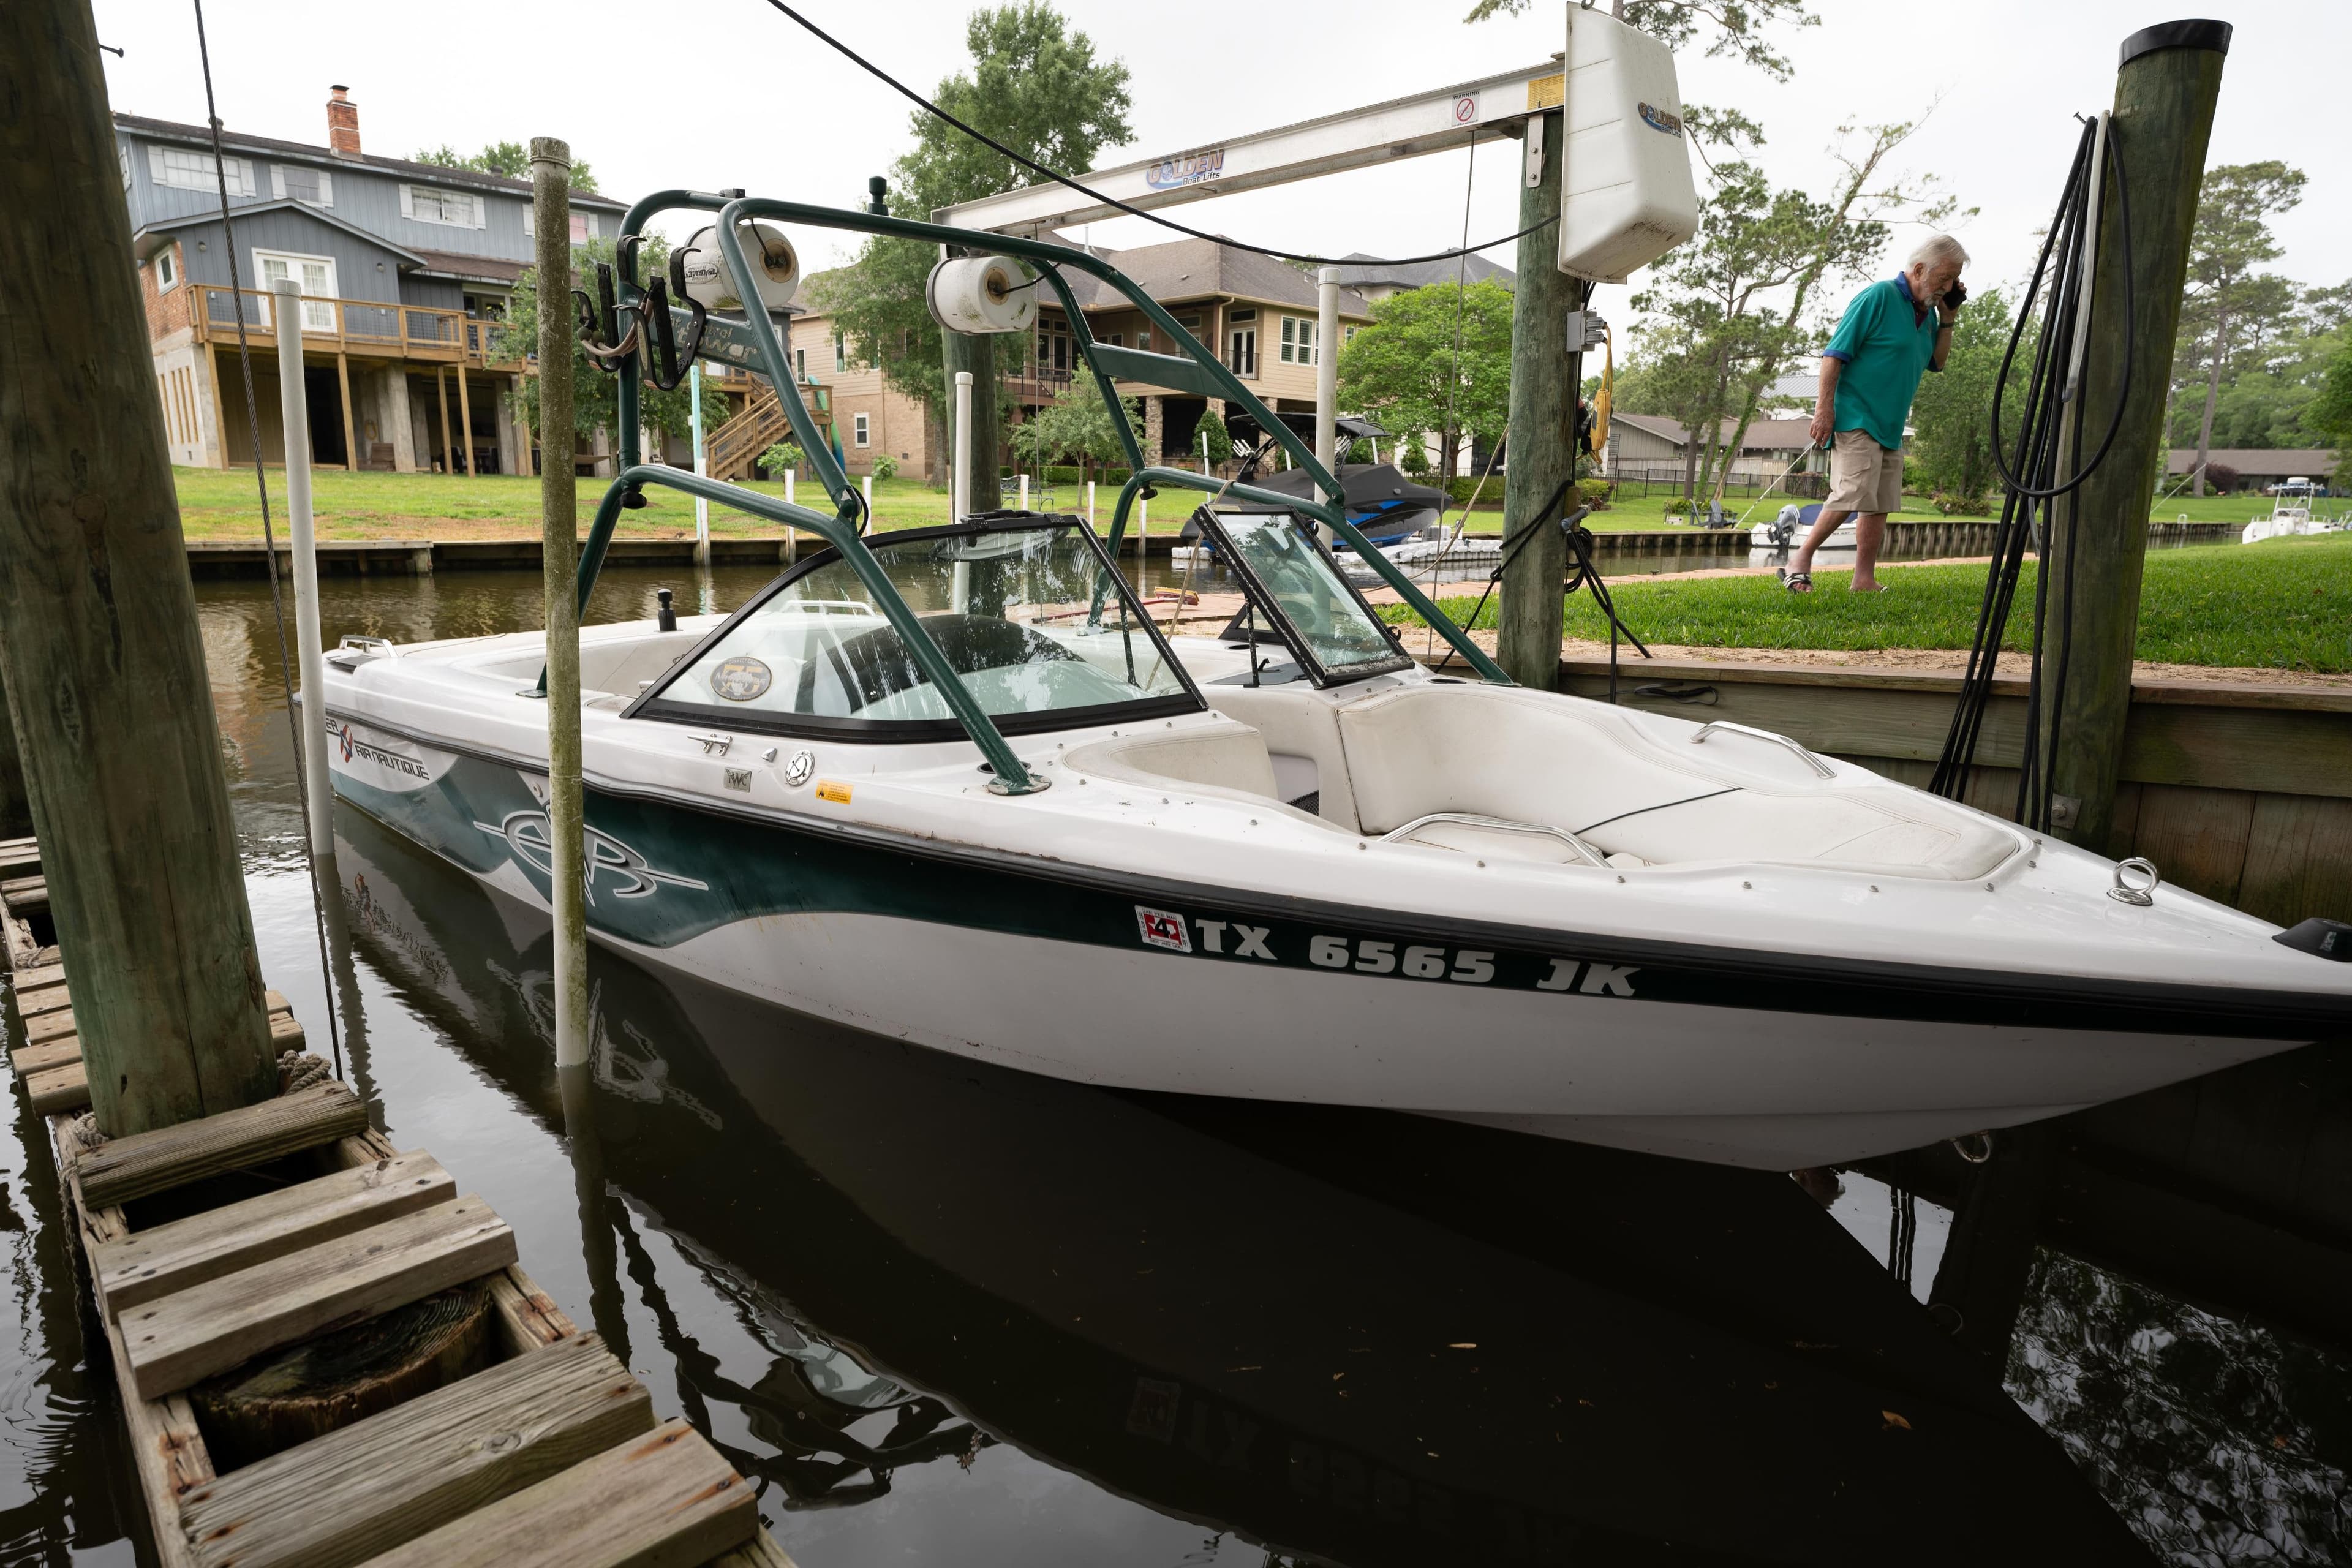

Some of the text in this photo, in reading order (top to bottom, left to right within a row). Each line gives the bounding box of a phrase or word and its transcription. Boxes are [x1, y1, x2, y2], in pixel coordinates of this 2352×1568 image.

[1453, 90, 1480, 100] WARNING
[1638, 102, 1681, 132] GOLDEN
[1147, 149, 1225, 184] GOLDEN
[1183, 171, 1221, 185] Boat Lifts
[355, 745, 430, 781] AIR NAUTIQUE
[1155, 918, 1170, 939] 4
[1196, 918, 1278, 960] TX
[1308, 935, 1495, 983] 6565
[1536, 959, 1643, 997] JK
